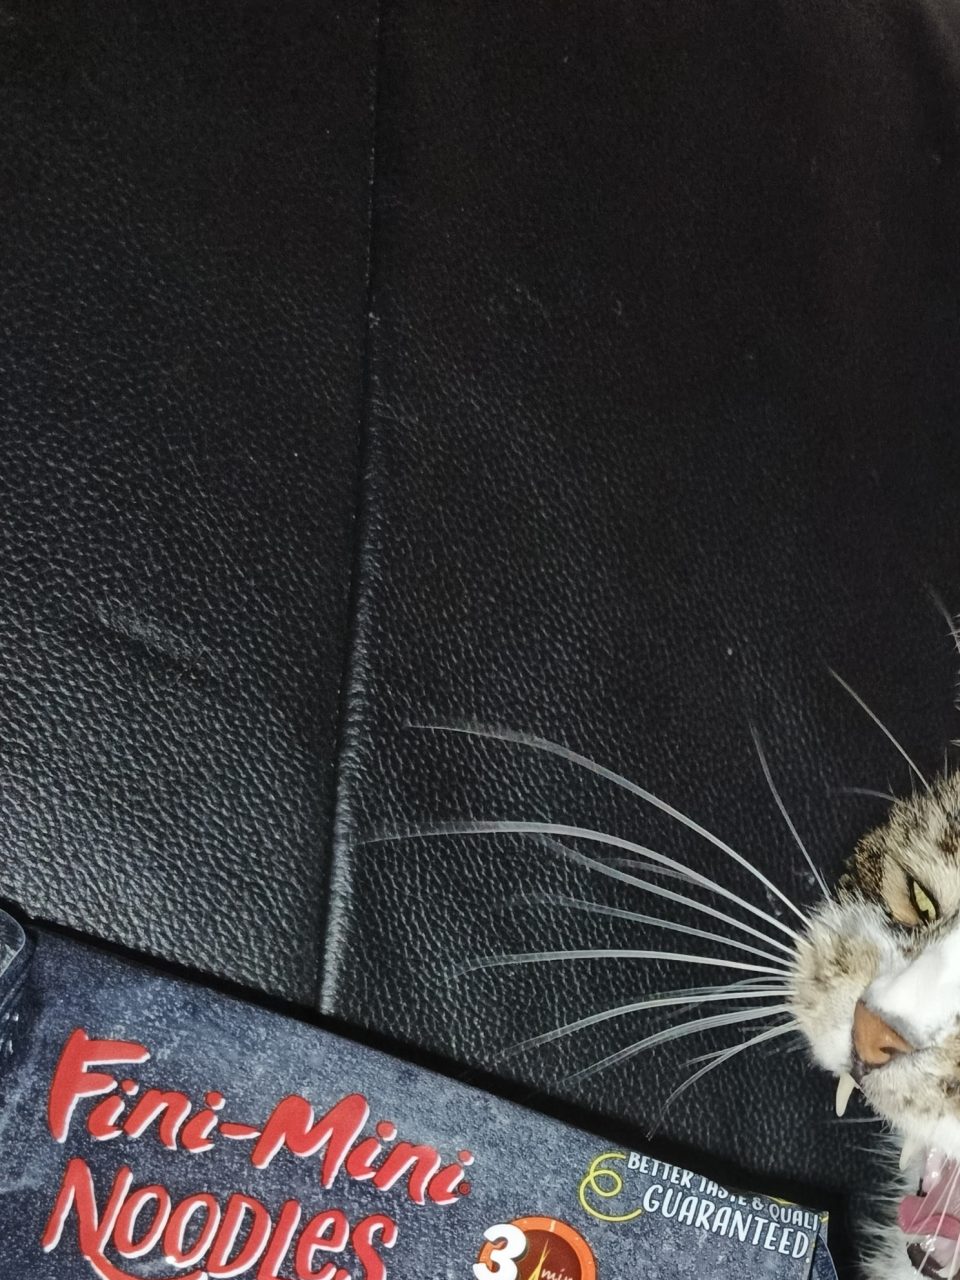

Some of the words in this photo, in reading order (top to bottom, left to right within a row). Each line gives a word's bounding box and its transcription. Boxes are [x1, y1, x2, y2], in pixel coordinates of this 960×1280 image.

[627, 1152, 694, 1188] BETTER
[752, 1197, 764, 1211] &
[768, 1204, 819, 1231] QUALI
[642, 1184, 811, 1264] GUARANTEED.
